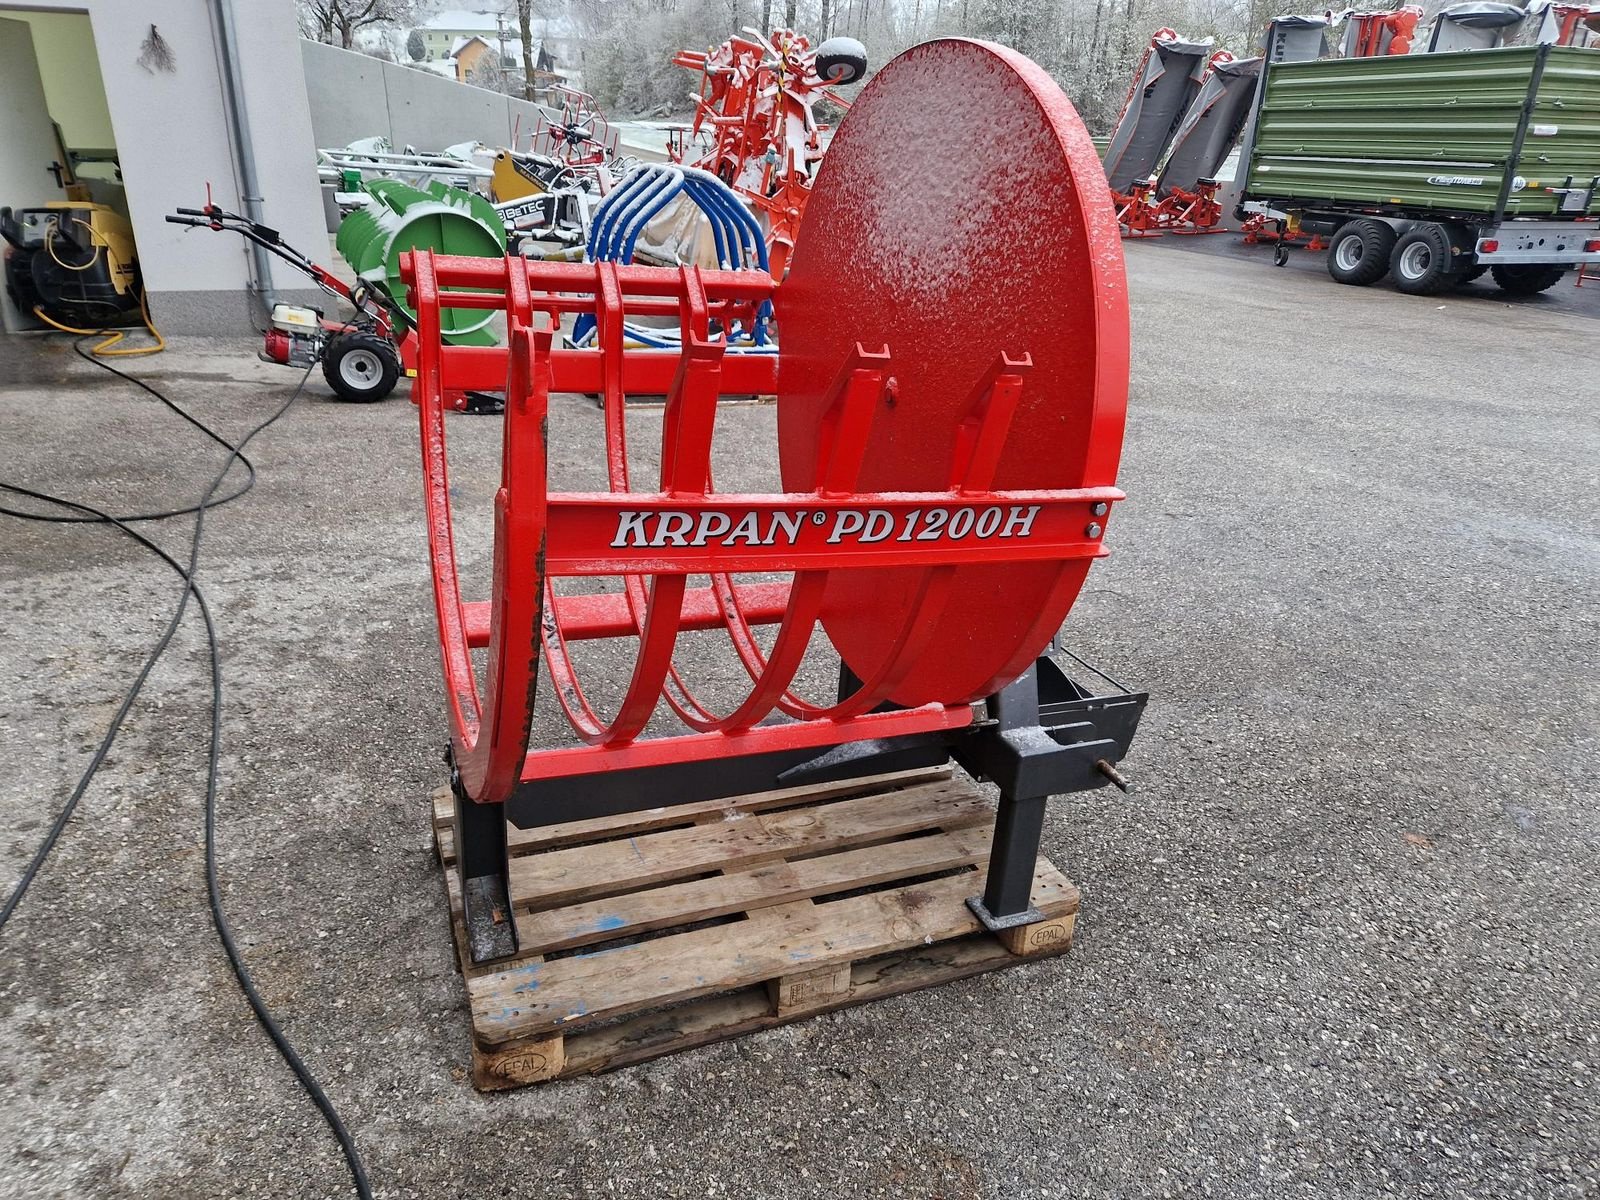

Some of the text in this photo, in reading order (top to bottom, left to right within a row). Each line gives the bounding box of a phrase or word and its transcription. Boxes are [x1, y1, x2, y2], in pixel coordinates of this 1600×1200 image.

[826, 508, 897, 544] PD
[896, 504, 1042, 541] 1200H
[1036, 928, 1060, 943] EPAL
